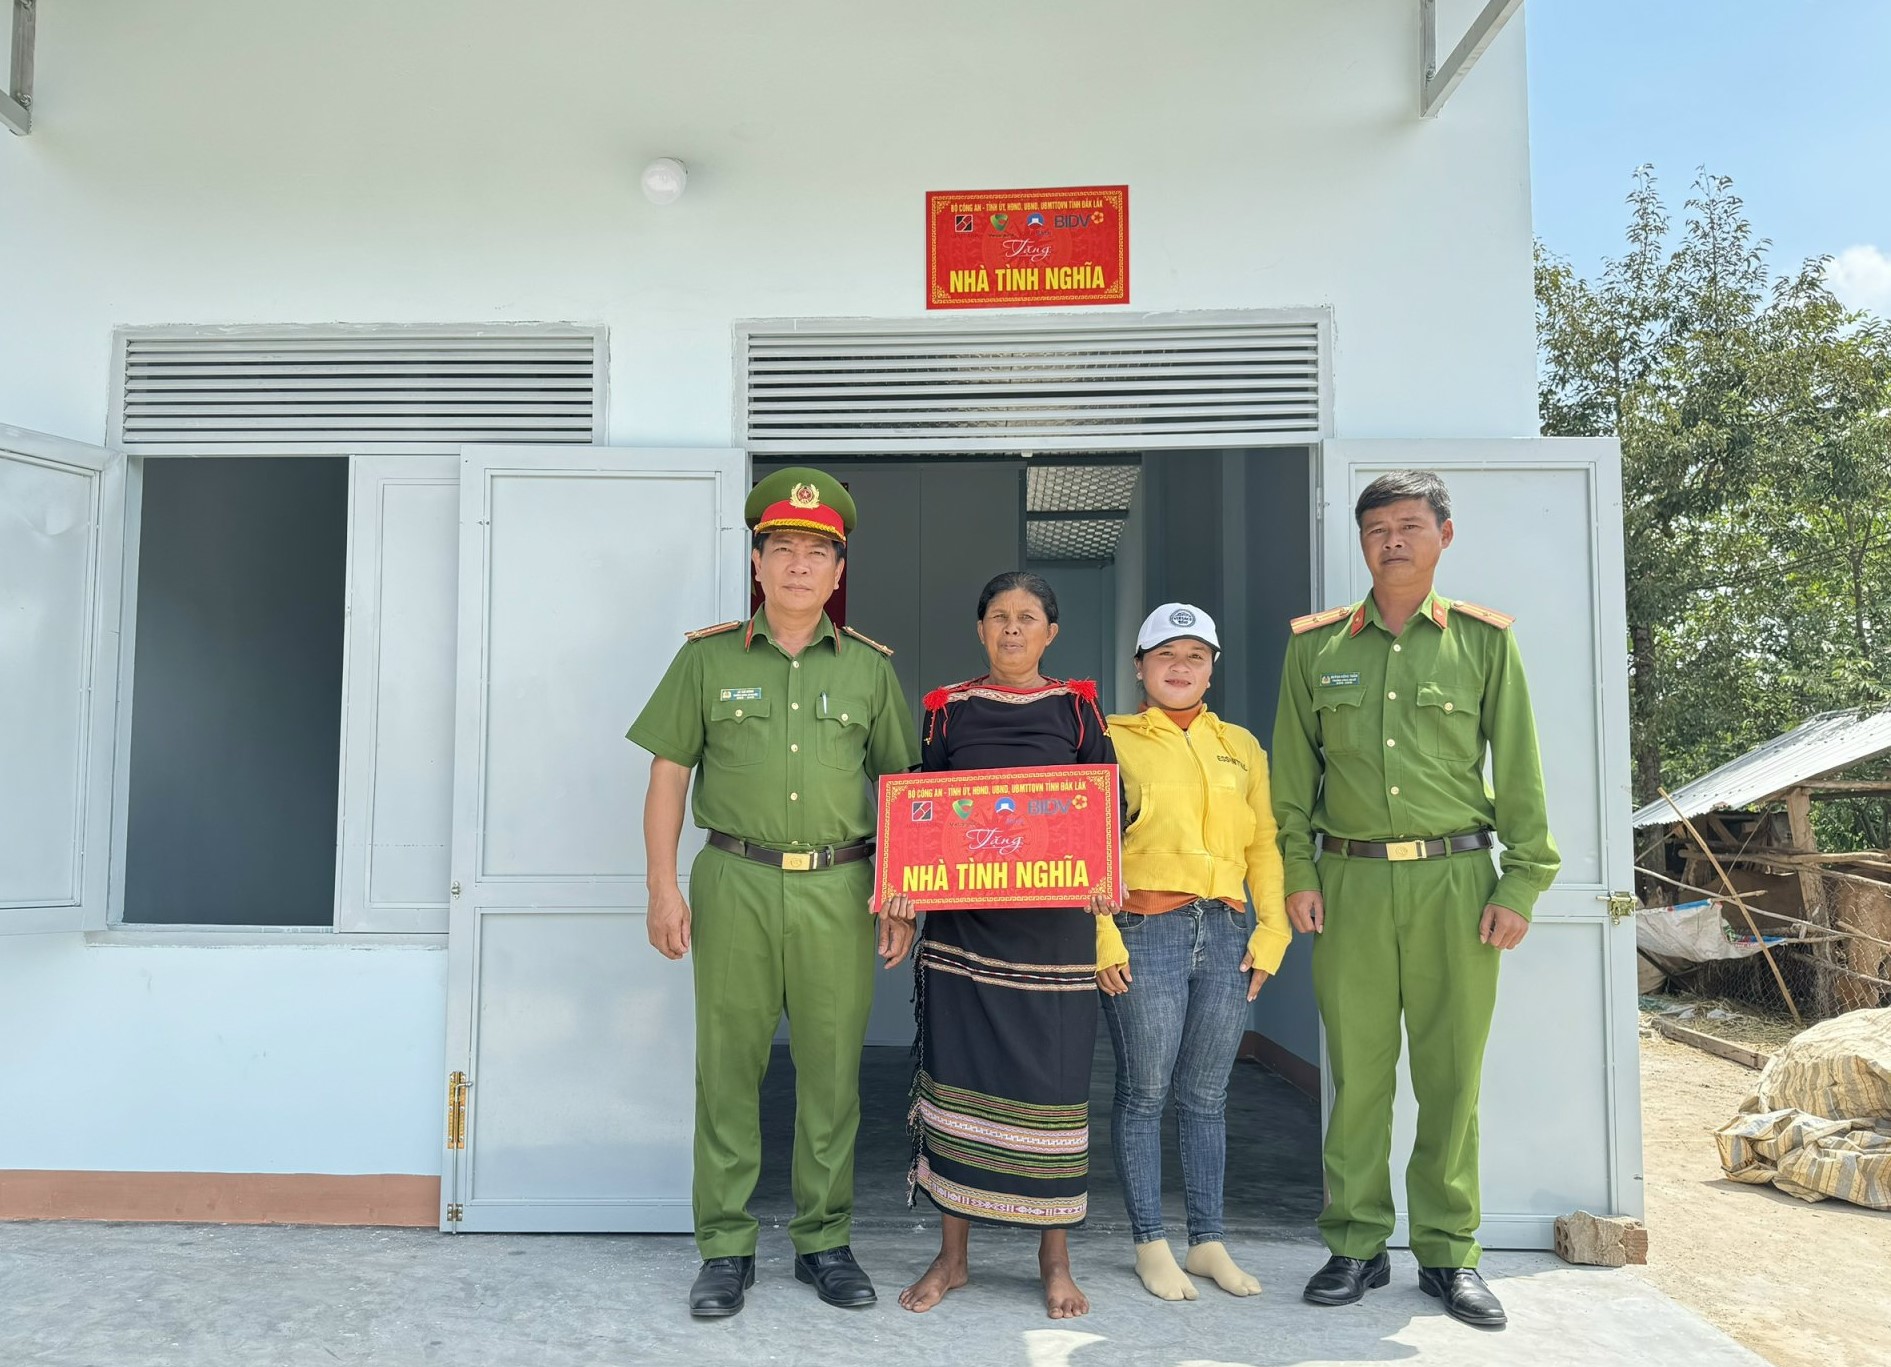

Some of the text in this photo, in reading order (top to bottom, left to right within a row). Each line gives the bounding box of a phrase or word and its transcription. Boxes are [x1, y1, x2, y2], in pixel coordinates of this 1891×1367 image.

[974, 204, 982, 212] AN
[1054, 213, 1092, 228] BIDV
[1002, 238, 1051, 262] Tặng
[950, 262, 1106, 293] NHÀ TÌNH NGHĨA
[908, 787, 916, 800] BỘ
[916, 786, 932, 798] CÔNG
[934, 788, 942, 798] AN
[1012, 782, 1044, 793] UBMTTQVN
[1027, 798, 1072, 816] BIDV
[966, 827, 1024, 856] Tặng
[903, 854, 1090, 892] NHÀ TÌNH NGHĨA
